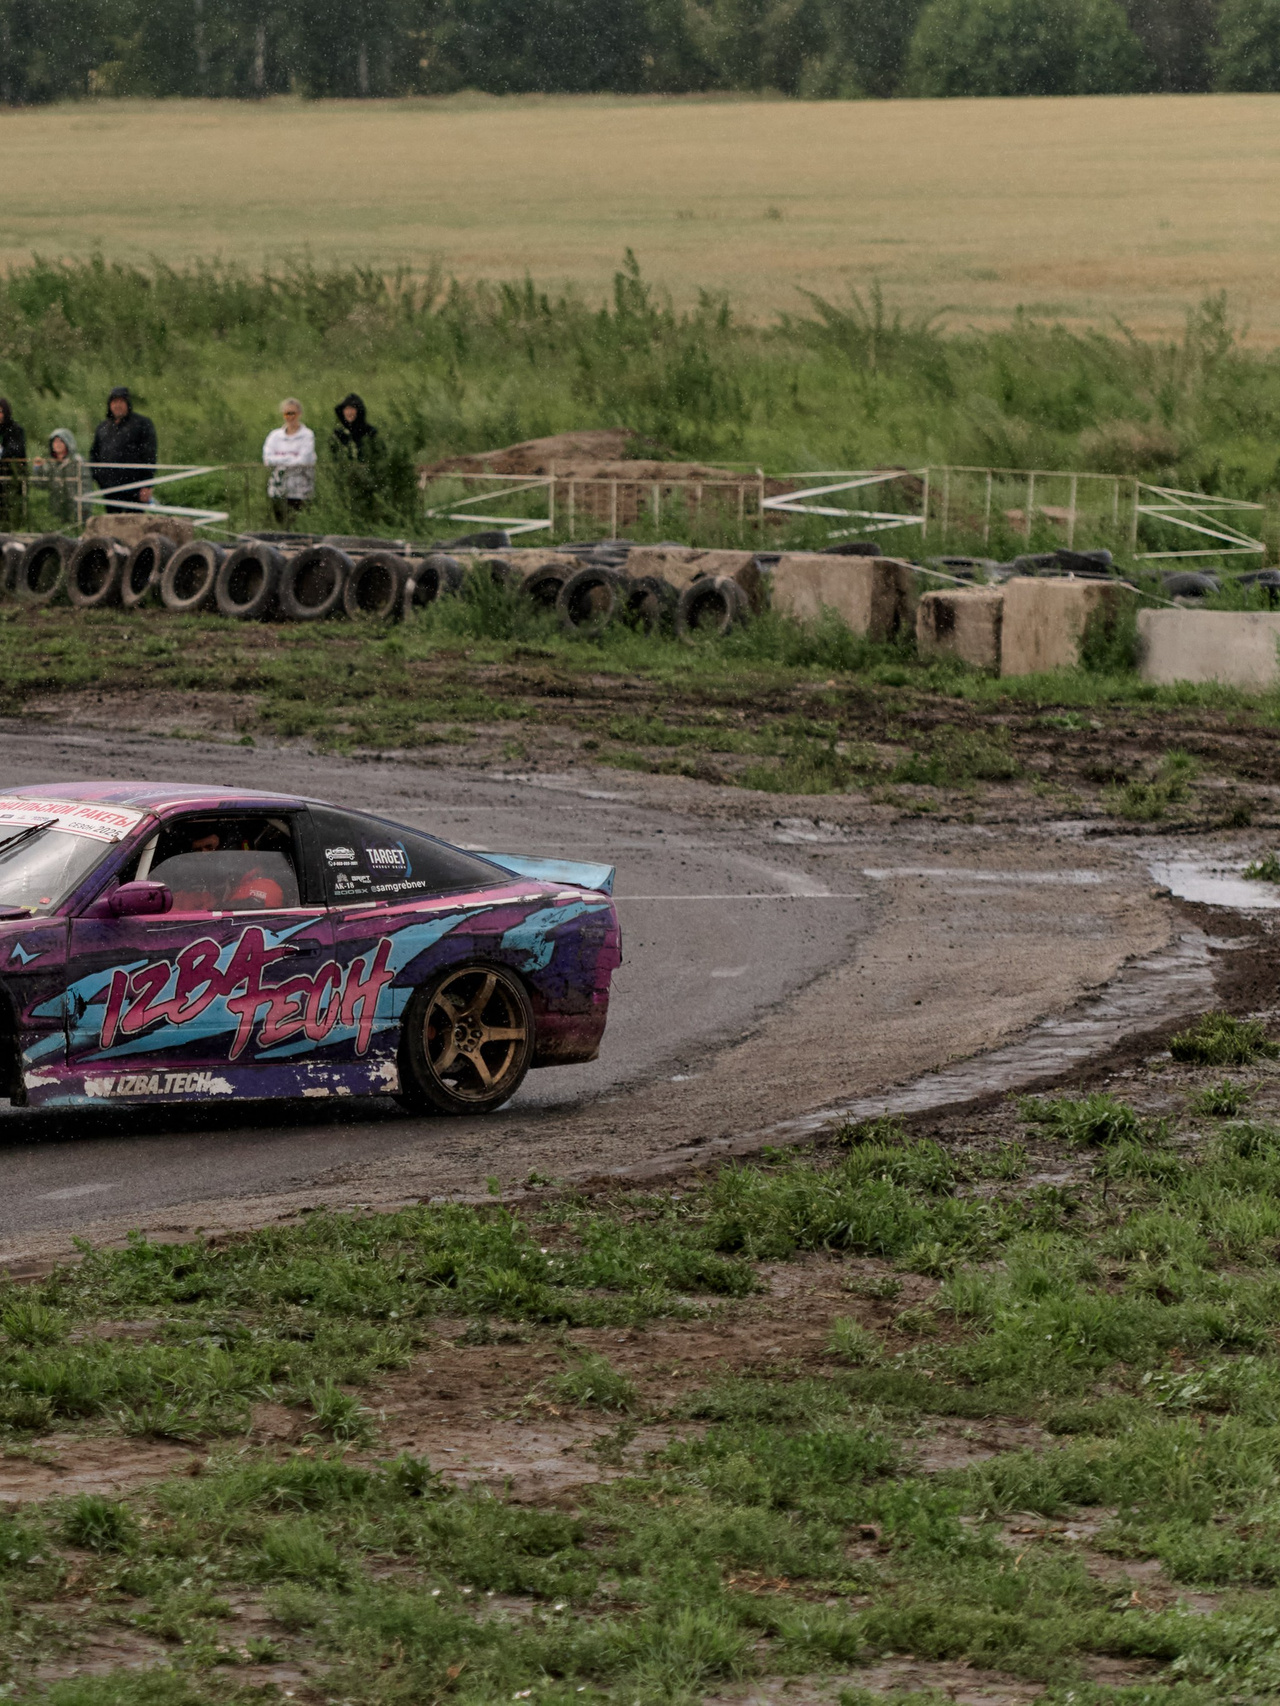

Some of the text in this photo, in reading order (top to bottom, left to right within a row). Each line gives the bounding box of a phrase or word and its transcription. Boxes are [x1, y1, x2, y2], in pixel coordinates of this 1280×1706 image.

[73, 808, 137, 828] РАКЕТЫ
[93, 825, 123, 837] 2025
[366, 848, 406, 864] TARGET
[371, 880, 426, 893] @samgrebnev
[99, 926, 299, 1050] IZBA
[226, 937, 395, 1061] TECH
